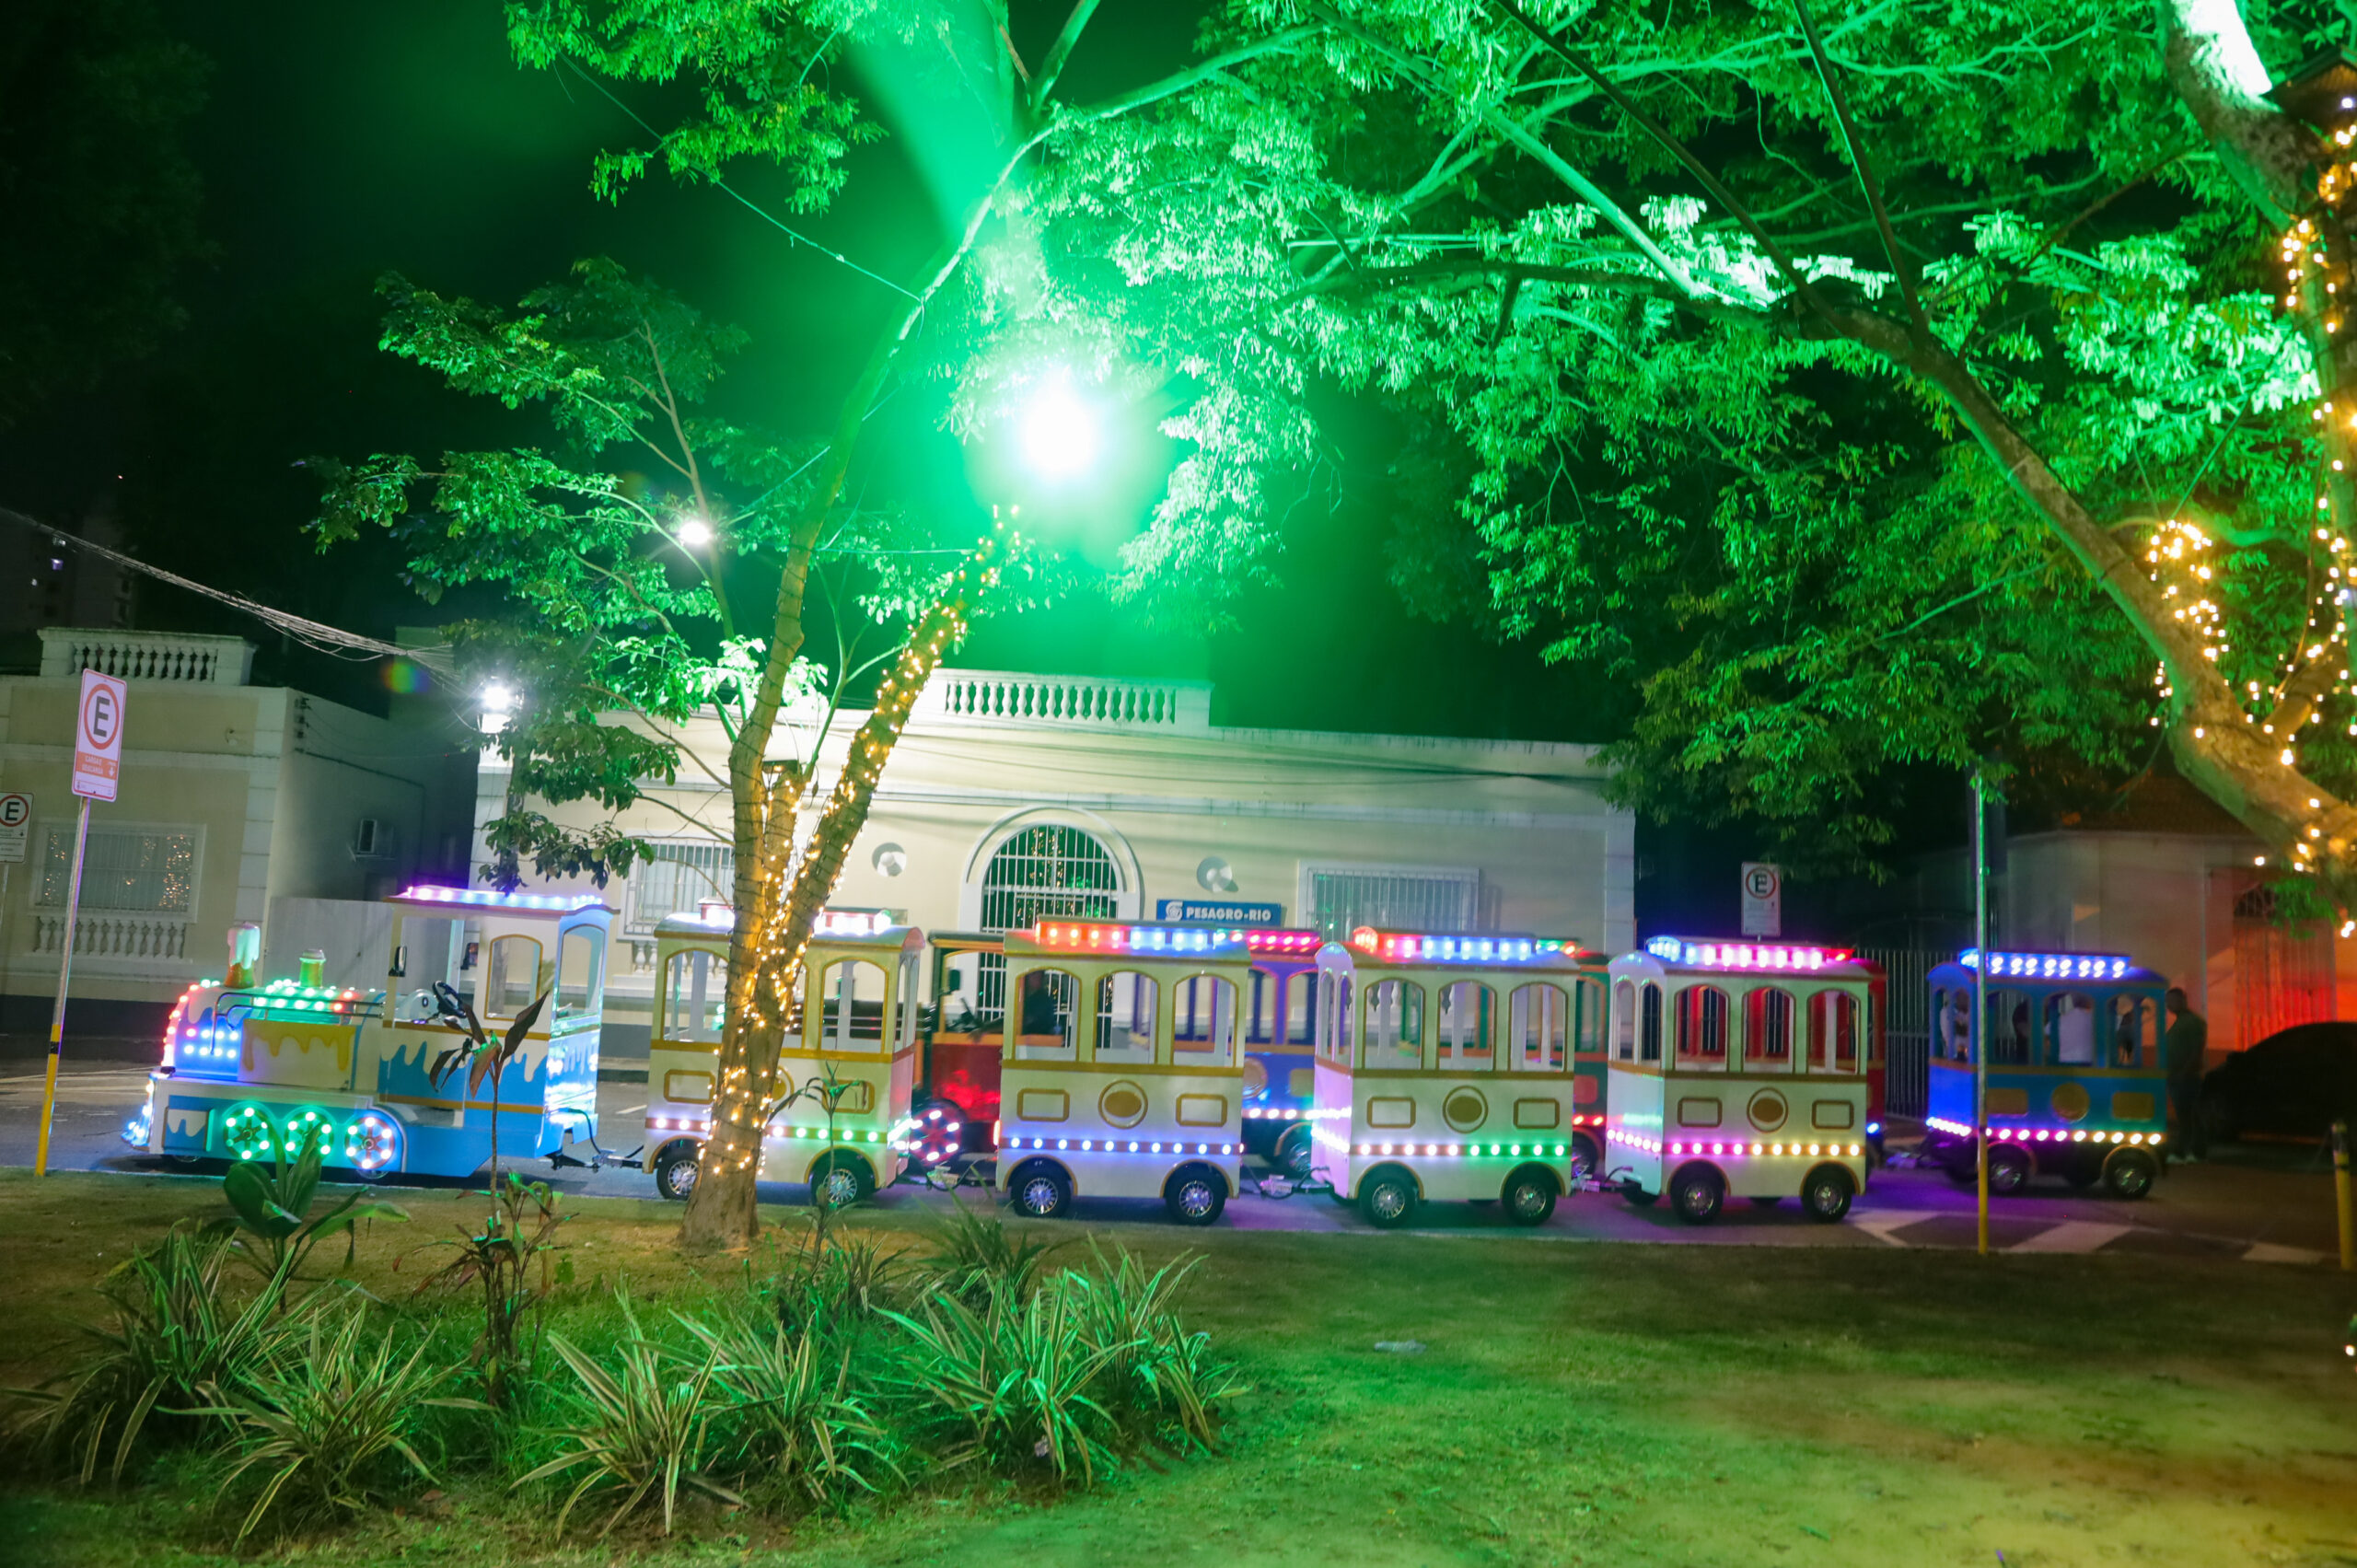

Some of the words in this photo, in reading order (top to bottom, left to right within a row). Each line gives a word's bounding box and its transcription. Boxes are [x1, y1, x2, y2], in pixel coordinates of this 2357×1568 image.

[93, 695, 110, 738] E
[5, 801, 20, 821] E
[1754, 874, 1768, 894] E
[1186, 906, 1271, 922] PESAGRO-RIO
